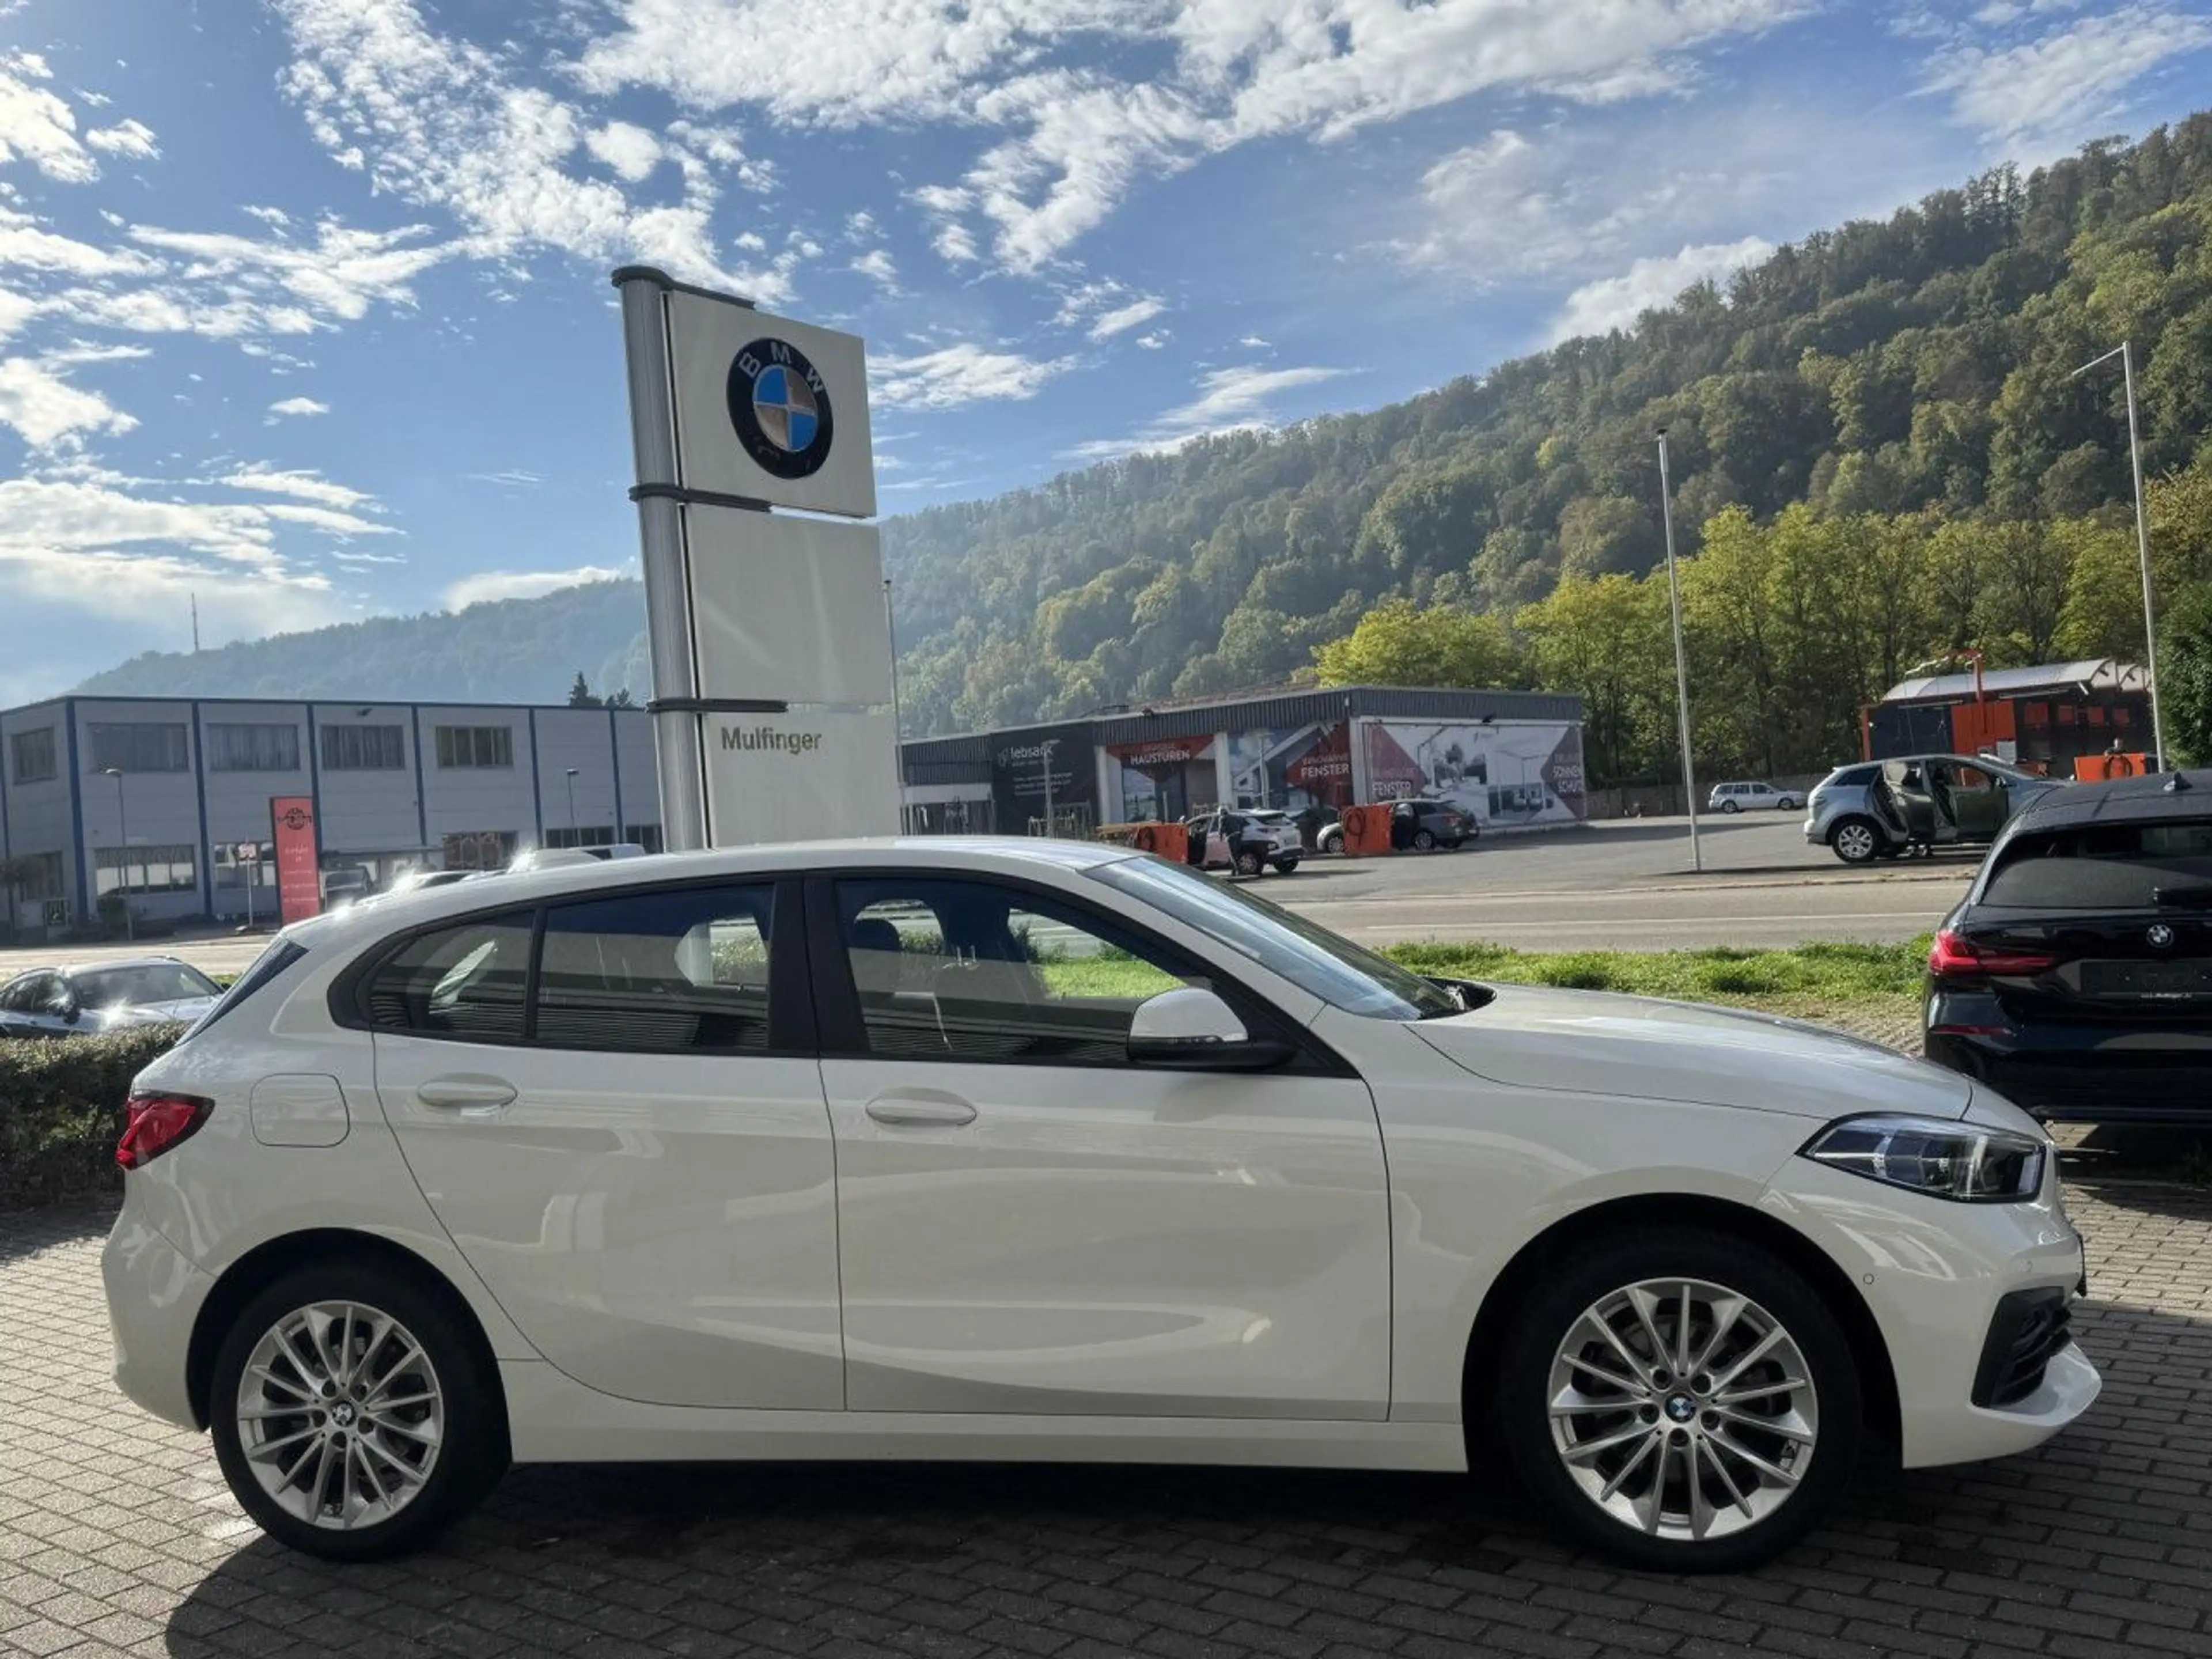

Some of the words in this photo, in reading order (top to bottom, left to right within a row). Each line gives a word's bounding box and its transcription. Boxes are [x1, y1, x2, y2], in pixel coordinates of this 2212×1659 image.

[739, 342, 825, 393] BMW
[721, 726, 822, 755] Mulfinger
[1301, 763, 1349, 778] FENSTER
